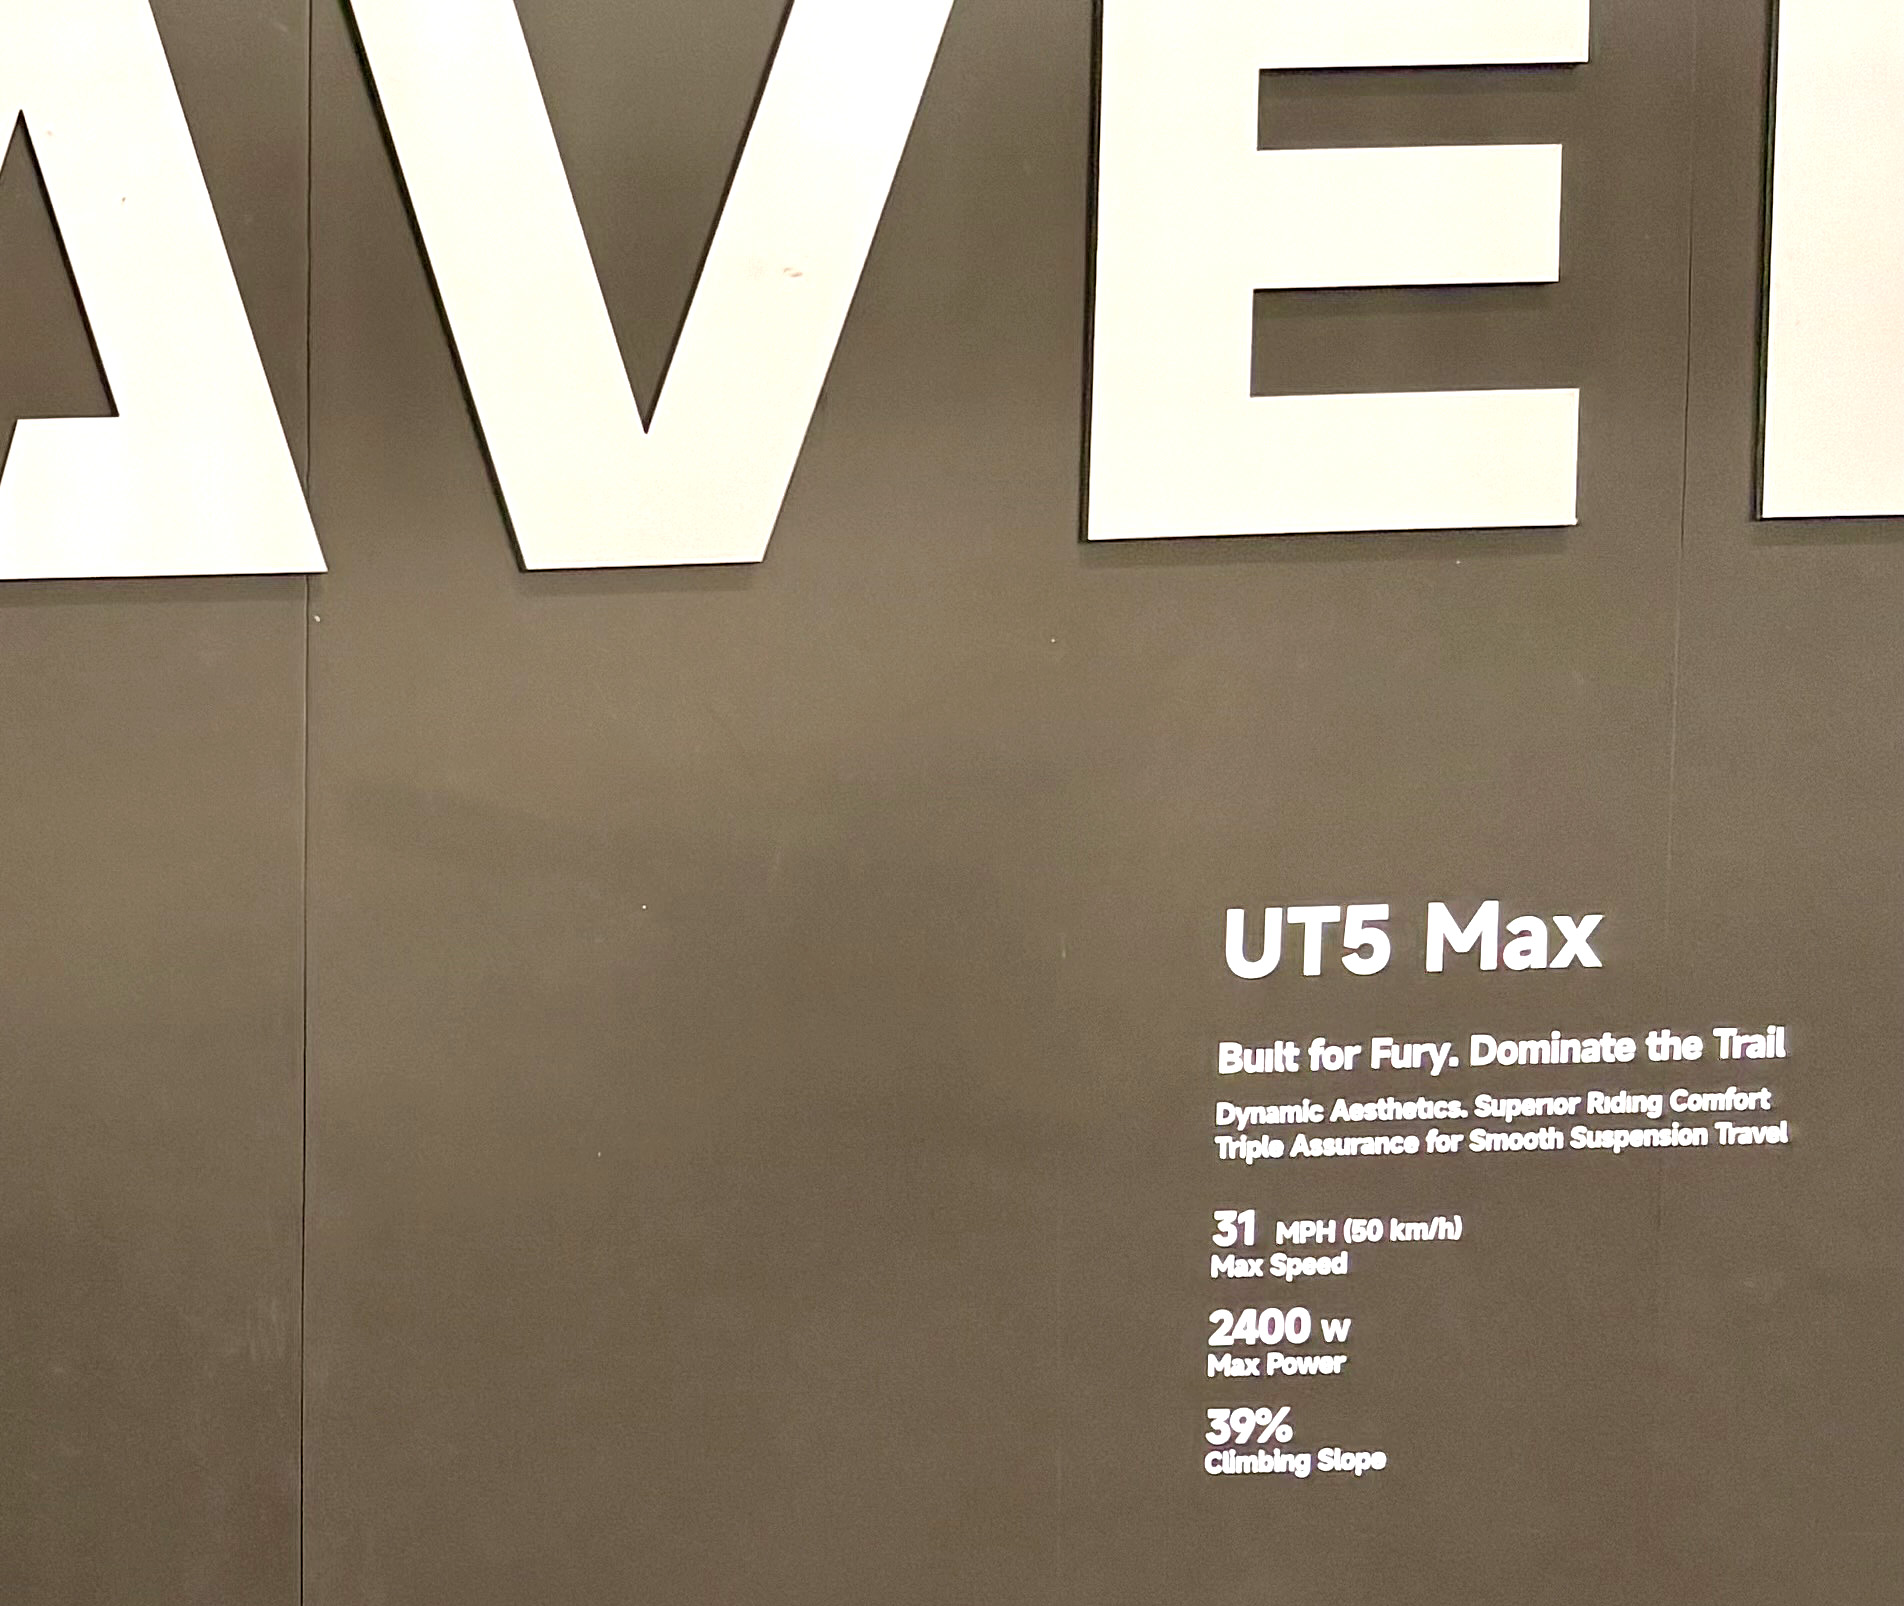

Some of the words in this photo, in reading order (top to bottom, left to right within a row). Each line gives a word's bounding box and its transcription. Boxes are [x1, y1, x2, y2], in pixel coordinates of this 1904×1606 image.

[1225, 903, 1391, 979] UT5
[1425, 900, 1605, 973] Max
[1217, 1040, 1301, 1075] Built
[1308, 1037, 1362, 1072] for
[1370, 1036, 1459, 1077] Fury.
[1470, 1030, 1637, 1067] Dominate
[1645, 1029, 1704, 1062] the
[1713, 1025, 1787, 1060] Trail
[1215, 1097, 1324, 1131] Dynamic
[1330, 1094, 1468, 1125] Aesthetics.
[1475, 1092, 1580, 1124] Superior
[1587, 1088, 1664, 1119] Riding
[1670, 1086, 1772, 1114] Comfort
[1214, 1134, 1284, 1165] Triple
[1289, 1131, 1420, 1159] Assurance
[1425, 1128, 1465, 1156] for
[1468, 1126, 1564, 1154] Smooth
[1569, 1121, 1710, 1155] Suspension
[1715, 1119, 1790, 1145] Travel
[1212, 1209, 1255, 1247] 31
[1275, 1219, 1337, 1245] MPH
[1343, 1217, 1384, 1244] (50
[1390, 1214, 1463, 1242] km/h)
[1210, 1254, 1264, 1279] Max
[1269, 1250, 1349, 1283] Speed
[1208, 1306, 1312, 1346] 2400
[1207, 1353, 1261, 1378] Max
[1266, 1351, 1347, 1376] Power
[1205, 1406, 1294, 1446] 39%
[1204, 1447, 1312, 1479] Climbing
[1317, 1446, 1387, 1477] Slope
